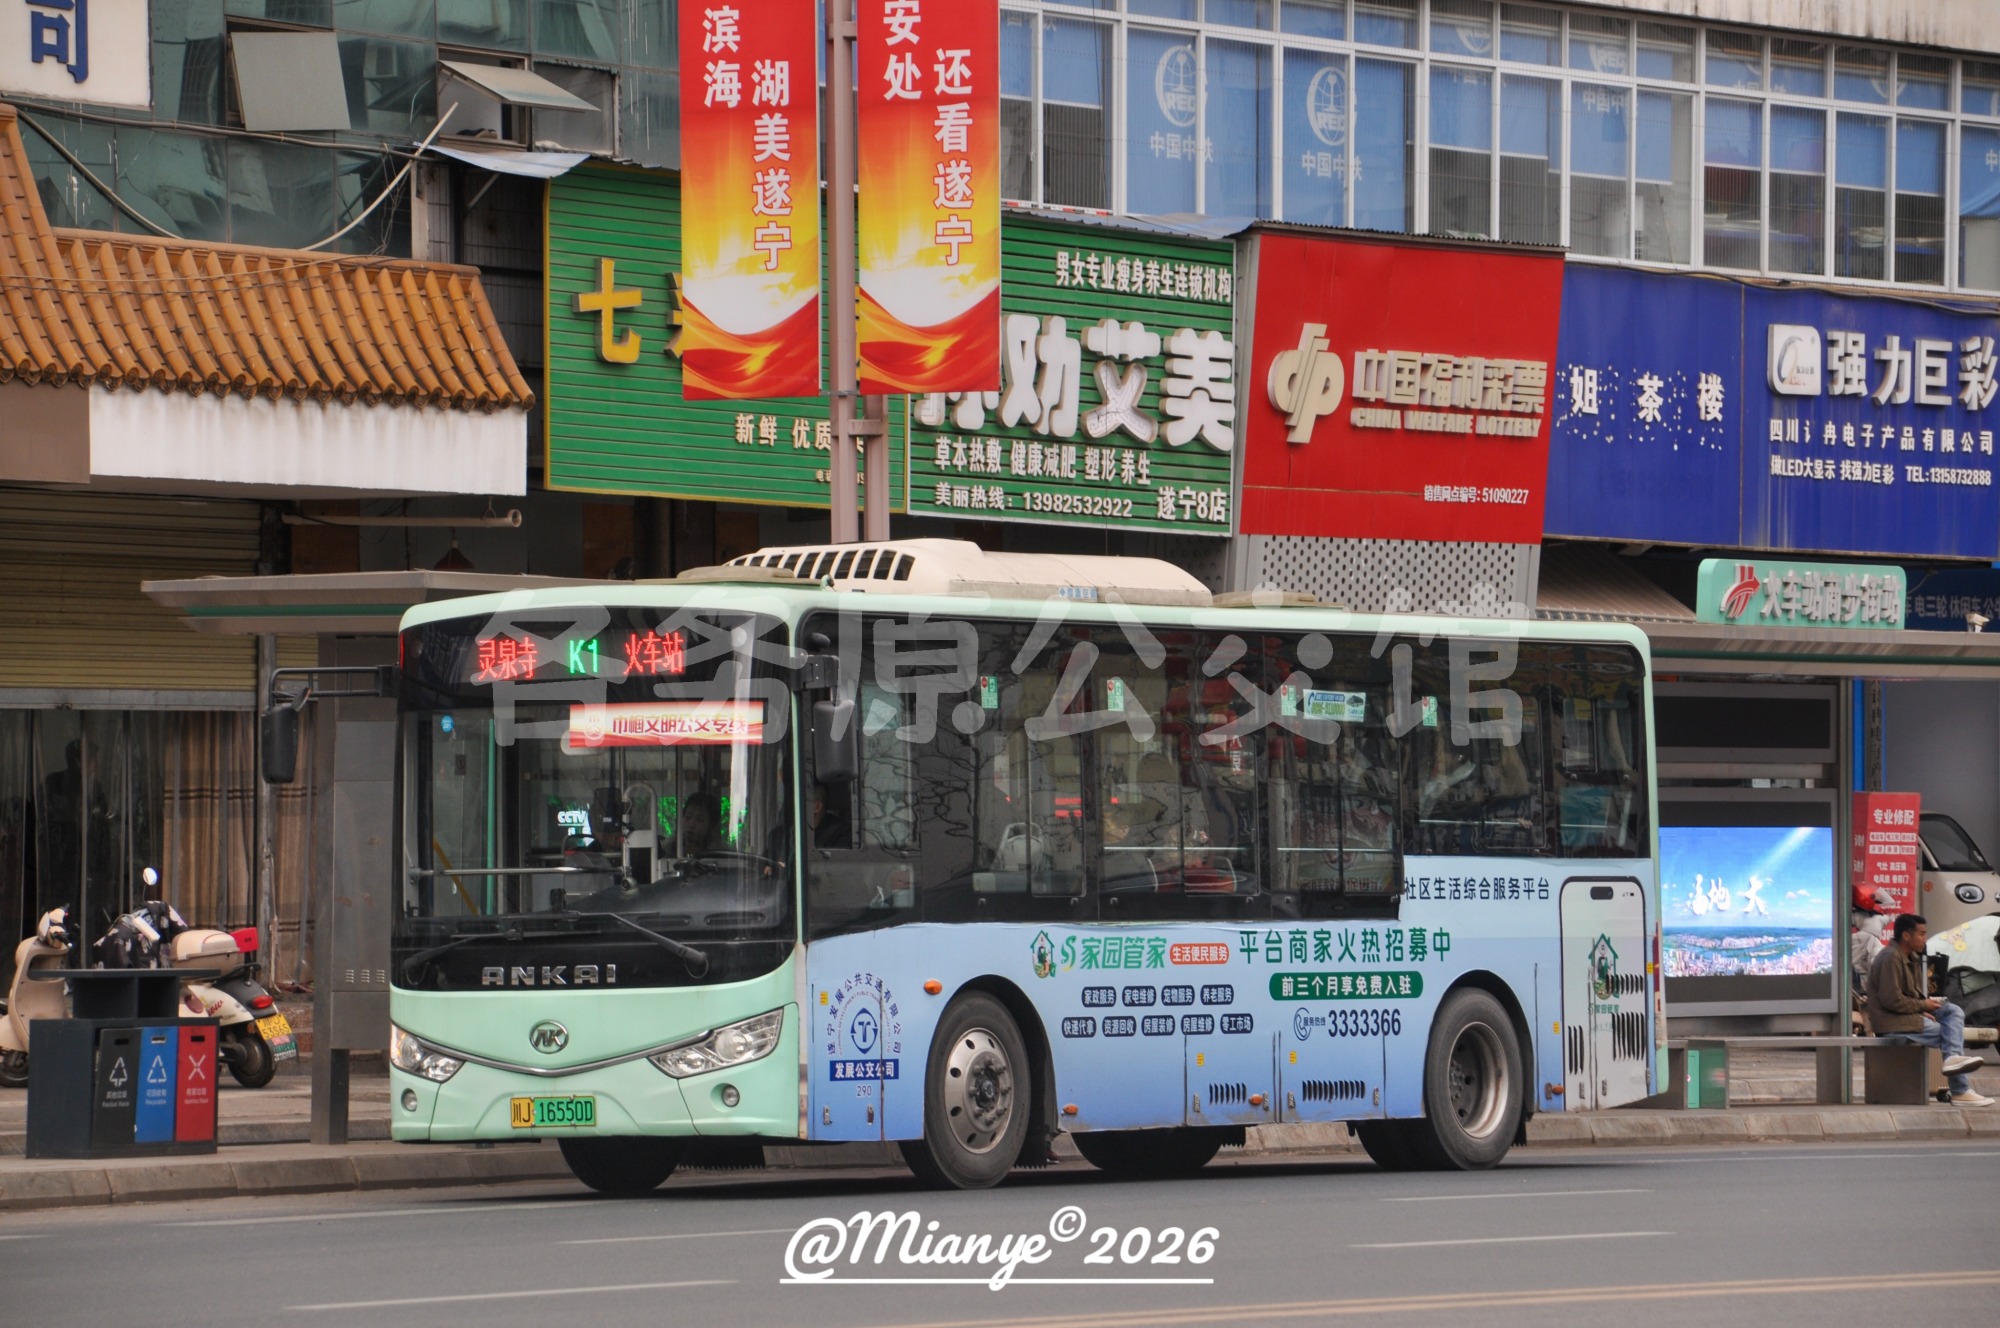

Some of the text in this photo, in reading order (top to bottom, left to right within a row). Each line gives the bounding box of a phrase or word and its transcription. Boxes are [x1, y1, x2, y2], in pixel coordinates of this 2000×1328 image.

[25, 0, 89, 84] 司
[702, 5, 742, 109] 滨海
[883, 0, 923, 101] 安处
[751, 60, 793, 271] 湖美遂宁
[933, 48, 974, 266] 还看遂宁
[1056, 251, 1232, 303] 男女专业瘦身养生连锁机构
[1352, 349, 1548, 414] 中国福利彩票
[1827, 331, 1998, 410] 强力巨彩
[735, 413, 778, 446] 新鲜
[1351, 407, 1541, 438] CHINA WELFARE LOTTERY
[935, 436, 1003, 474] 草本热敷
[1010, 440, 1077, 480] 健康减肥
[1770, 454, 1836, 480] 做LED大显示
[1839, 458, 1895, 486] 找强力巨彩
[1022, 491, 1133, 518] 13982532922
[1156, 486, 1227, 523] 遂宁8店
[477, 630, 686, 681] 灵泉寺 K1 火车站
[1873, 808, 1915, 826] 专业修配
[1404, 876, 1549, 900] 社区生活综合服务平台
[1171, 945, 1229, 963] 生活便民服务
[1239, 926, 1451, 965] 平台商家火热招募中
[481, 963, 618, 986] ANKAI
[1281, 974, 1412, 998] 前三个月享免费入驻
[1083, 986, 1233, 1006] 家政服务 家电维修 宠物服务 养老服务
[1103, 1018, 1135, 1036] 资源回收
[1143, 1017, 1174, 1035] 房屋装修
[1183, 1016, 1213, 1034] 房屋维修
[1222, 1015, 1251, 1033] 零工市场
[1328, 1007, 1401, 1037] 3333366
[834, 1061, 895, 1079] 发展公交公司
[856, 1084, 873, 1098] 290
[539, 1100, 593, 1123] 16550D
